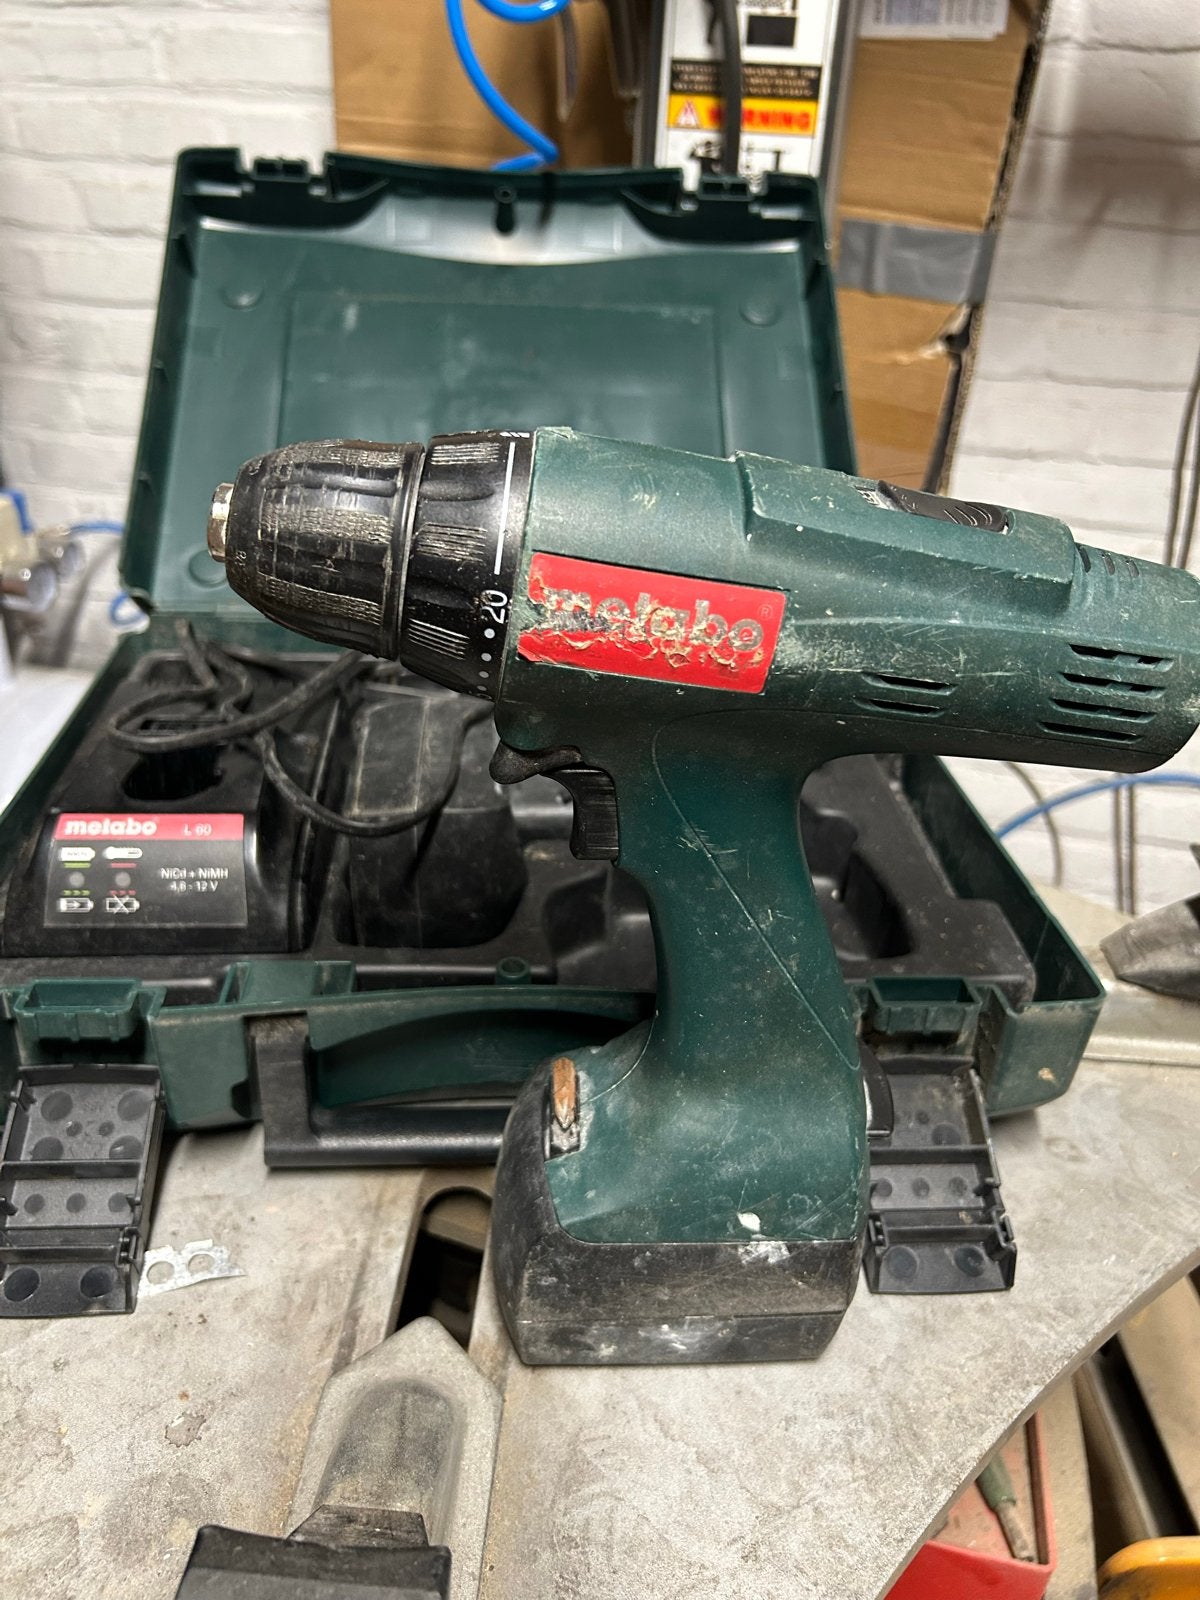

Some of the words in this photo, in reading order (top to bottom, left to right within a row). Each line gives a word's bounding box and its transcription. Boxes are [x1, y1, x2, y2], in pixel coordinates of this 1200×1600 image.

[480, 589, 508, 624] 20
[544, 588, 765, 652] metabo
[64, 818, 158, 836] metabo
[160, 867, 187, 880] NiCd
[198, 867, 229, 880] NiMH
[210, 880, 219, 893] V
